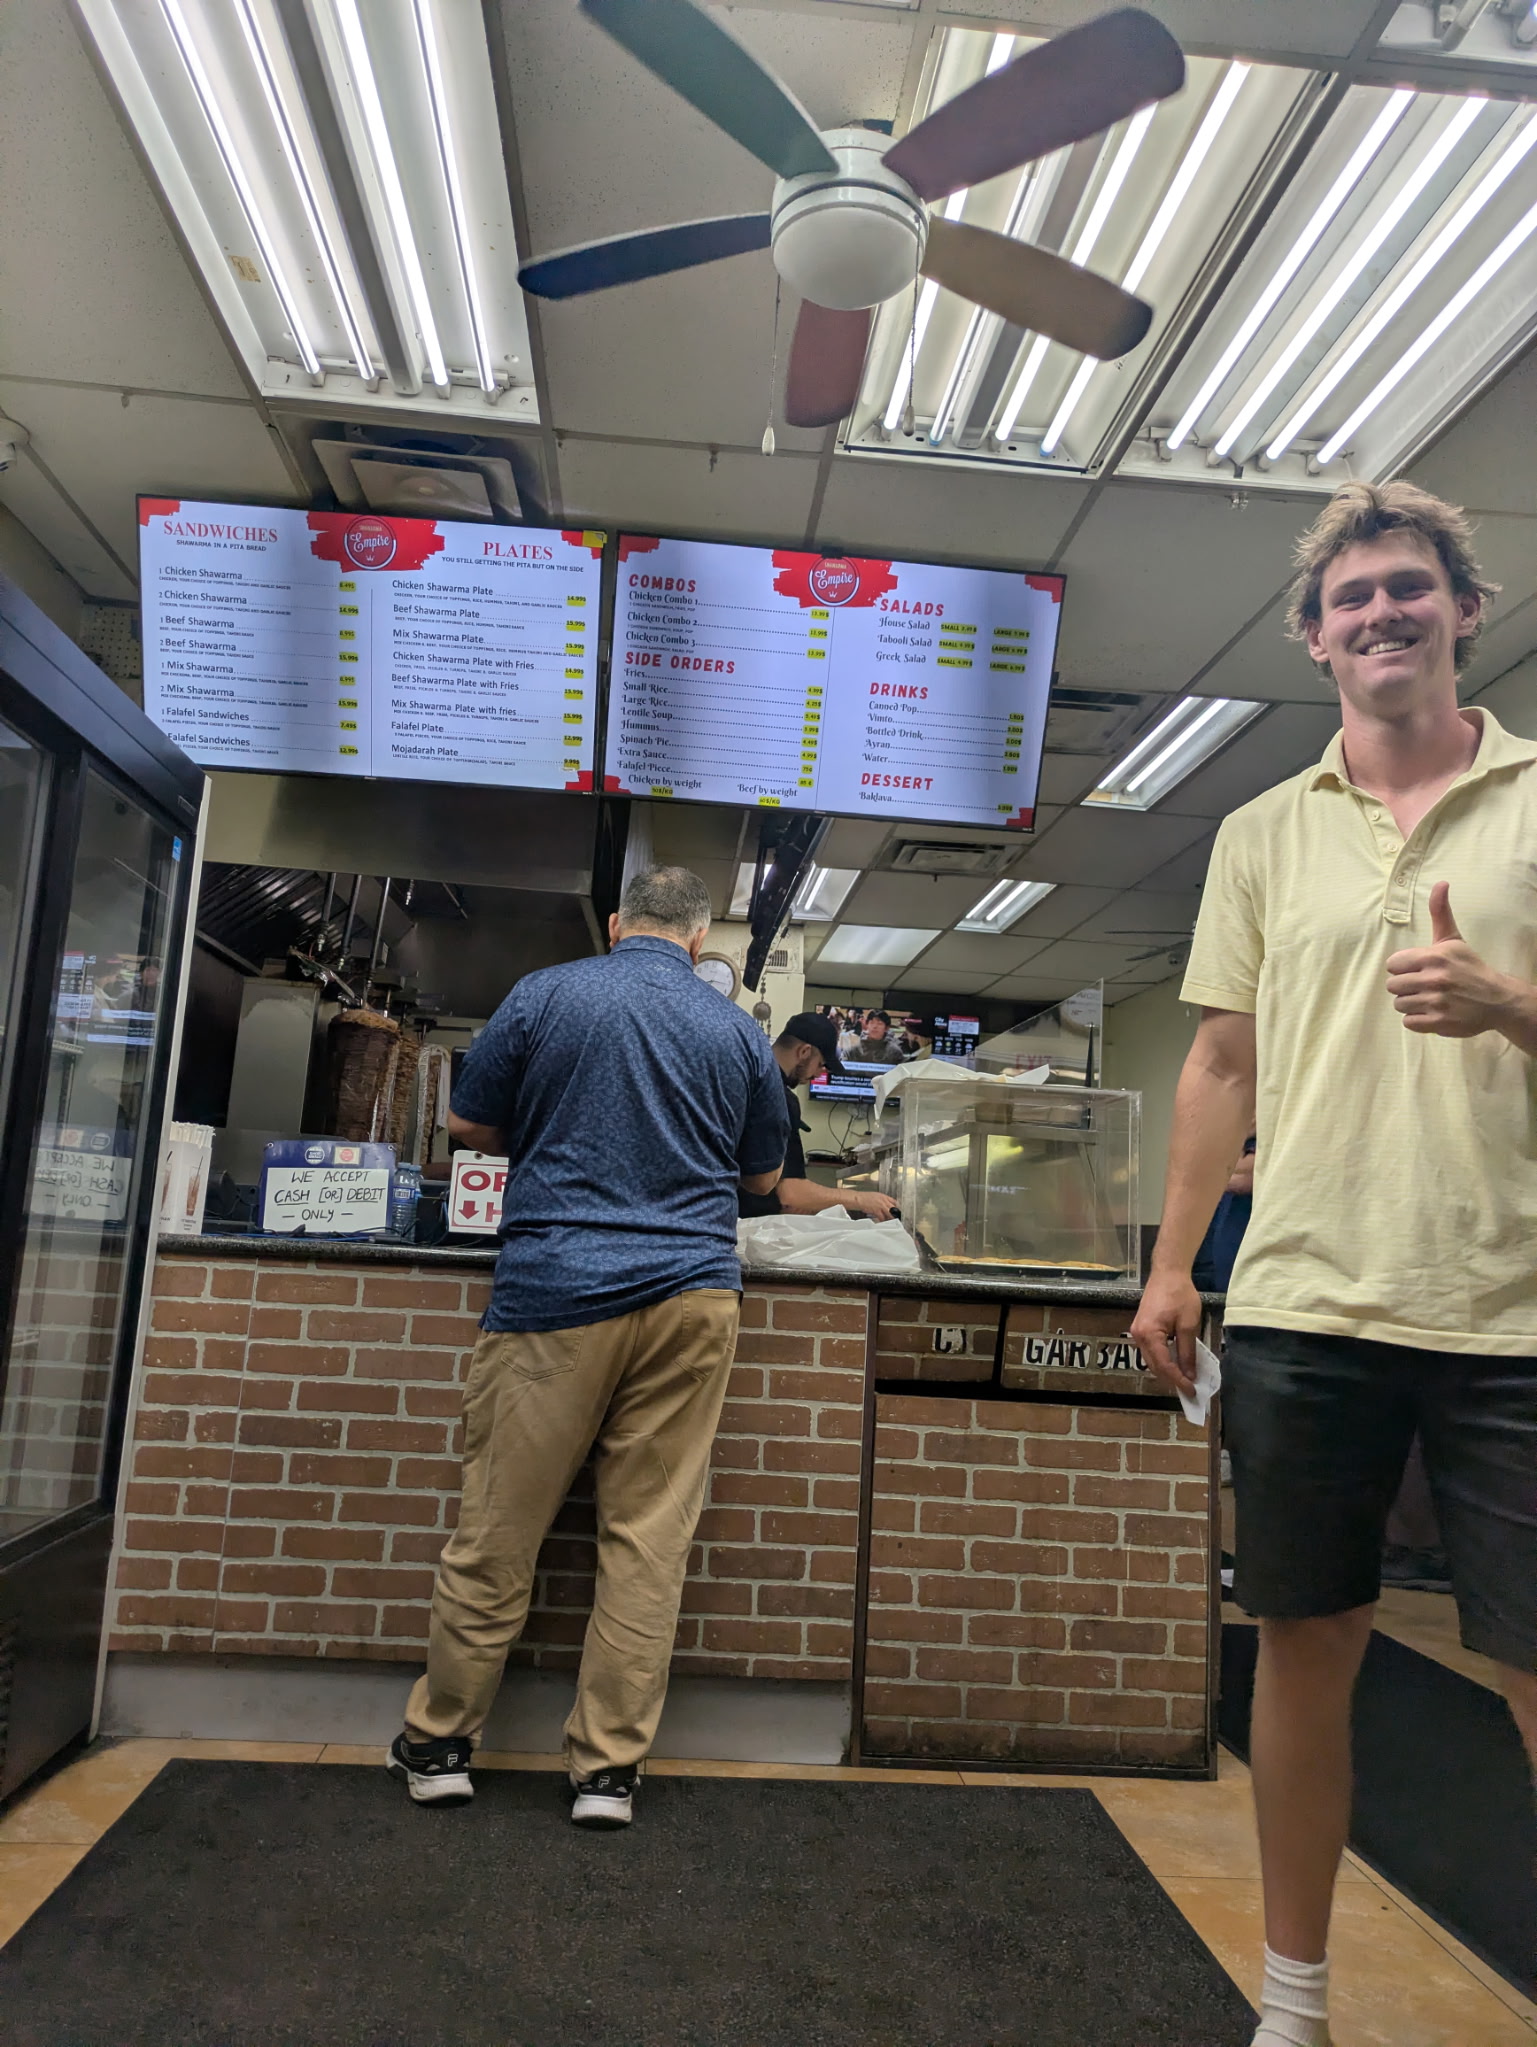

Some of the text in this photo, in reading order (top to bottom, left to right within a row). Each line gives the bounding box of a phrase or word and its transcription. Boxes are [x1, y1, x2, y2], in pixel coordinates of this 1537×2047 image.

[163, 520, 278, 543] SANDWICHES
[350, 532, 390, 553] Empire
[483, 541, 553, 560] PLATES
[165, 566, 197, 576] Chicken
[199, 569, 242, 580] Shawarma
[815, 569, 853, 589] Empire
[392, 580, 424, 590] Chicken
[427, 582, 469, 594] Shawarma
[472, 586, 493, 596] Plate
[629, 574, 696, 592] COMBOS
[164, 590, 198, 600] Chicken
[201, 593, 247, 604] Shawarma
[629, 591, 662, 602] Chicken
[664, 594, 693, 605] Combo
[393, 604, 412, 613] Beef
[414, 606, 456, 616] Shawarma
[460, 609, 480, 618] Plate
[880, 599, 944, 616] SALADS
[165, 615, 185, 624] Beef
[188, 617, 234, 628] Shawarma
[628, 612, 660, 623] Chicken
[662, 615, 691, 625] Combo
[879, 616, 905, 628] House
[908, 620, 930, 630] Salad
[393, 629, 409, 638] Mix
[412, 631, 459, 641] Shawarma
[462, 634, 484, 644] Plate
[626, 631, 659, 642] Chicken
[661, 634, 689, 645] Combo
[878, 634, 908, 645] Tabooli
[910, 638, 932, 647] Salad
[165, 638, 186, 646] Beef
[189, 640, 236, 651] Shawarma
[393, 652, 424, 661] Chicken
[427, 654, 469, 665] Shawarma
[472, 658, 492, 666] Plate
[495, 660, 513, 668] with
[515, 661, 534, 670] Fries
[625, 652, 735, 674] SIDE ORDERS
[876, 651, 901, 662] Greek
[904, 654, 926, 663] Salad
[167, 661, 184, 670] Mix
[186, 662, 233, 673] Shawarma
[624, 668, 645, 678] Fries
[392, 674, 410, 682] Beef
[412, 675, 454, 686] Shawarma
[457, 678, 477, 687] Plate
[500, 681, 519, 690] Fries
[623, 682, 668, 694] Small Rice
[167, 685, 184, 693] Mix
[187, 686, 234, 697] Shawarma
[870, 682, 928, 700] DRINKS
[392, 699, 407, 708] Mix
[410, 701, 452, 711] Shawarma
[455, 704, 475, 713] Plate
[499, 707, 516, 716] fries
[622, 695, 668, 707] Large Rice
[869, 701, 917, 714] Canned Pop
[167, 707, 195, 717] Falafel
[198, 710, 249, 721] Sandwiches
[621, 707, 673, 721] Lentile Soup
[868, 713, 893, 722] Vimto
[391, 722, 419, 731] Falafel
[422, 724, 444, 732] Plate
[621, 720, 660, 731] Hummus
[168, 733, 196, 742] Falafel
[198, 735, 250, 746] Sandwiches
[620, 734, 669, 746] Spinach Pie
[866, 726, 923, 740] Bottled Drink
[392, 744, 435, 755] Mojadarah
[438, 748, 458, 756] Plate
[864, 739, 890, 749] Ayran
[618, 747, 667, 759] Extra Sauce
[862, 753, 888, 762] Water
[617, 760, 670, 773] Falafel Piece
[628, 774, 702, 789] Chicken by weight
[861, 773, 933, 790] DESSERT
[737, 784, 798, 797] Beef by weight
[859, 792, 892, 802] Baklava
[291, 1170, 370, 1183] WE ACCEPT
[274, 1189, 310, 1204] CASH
[346, 1187, 386, 1200] DEBIT
[302, 1209, 334, 1223] ONLY
